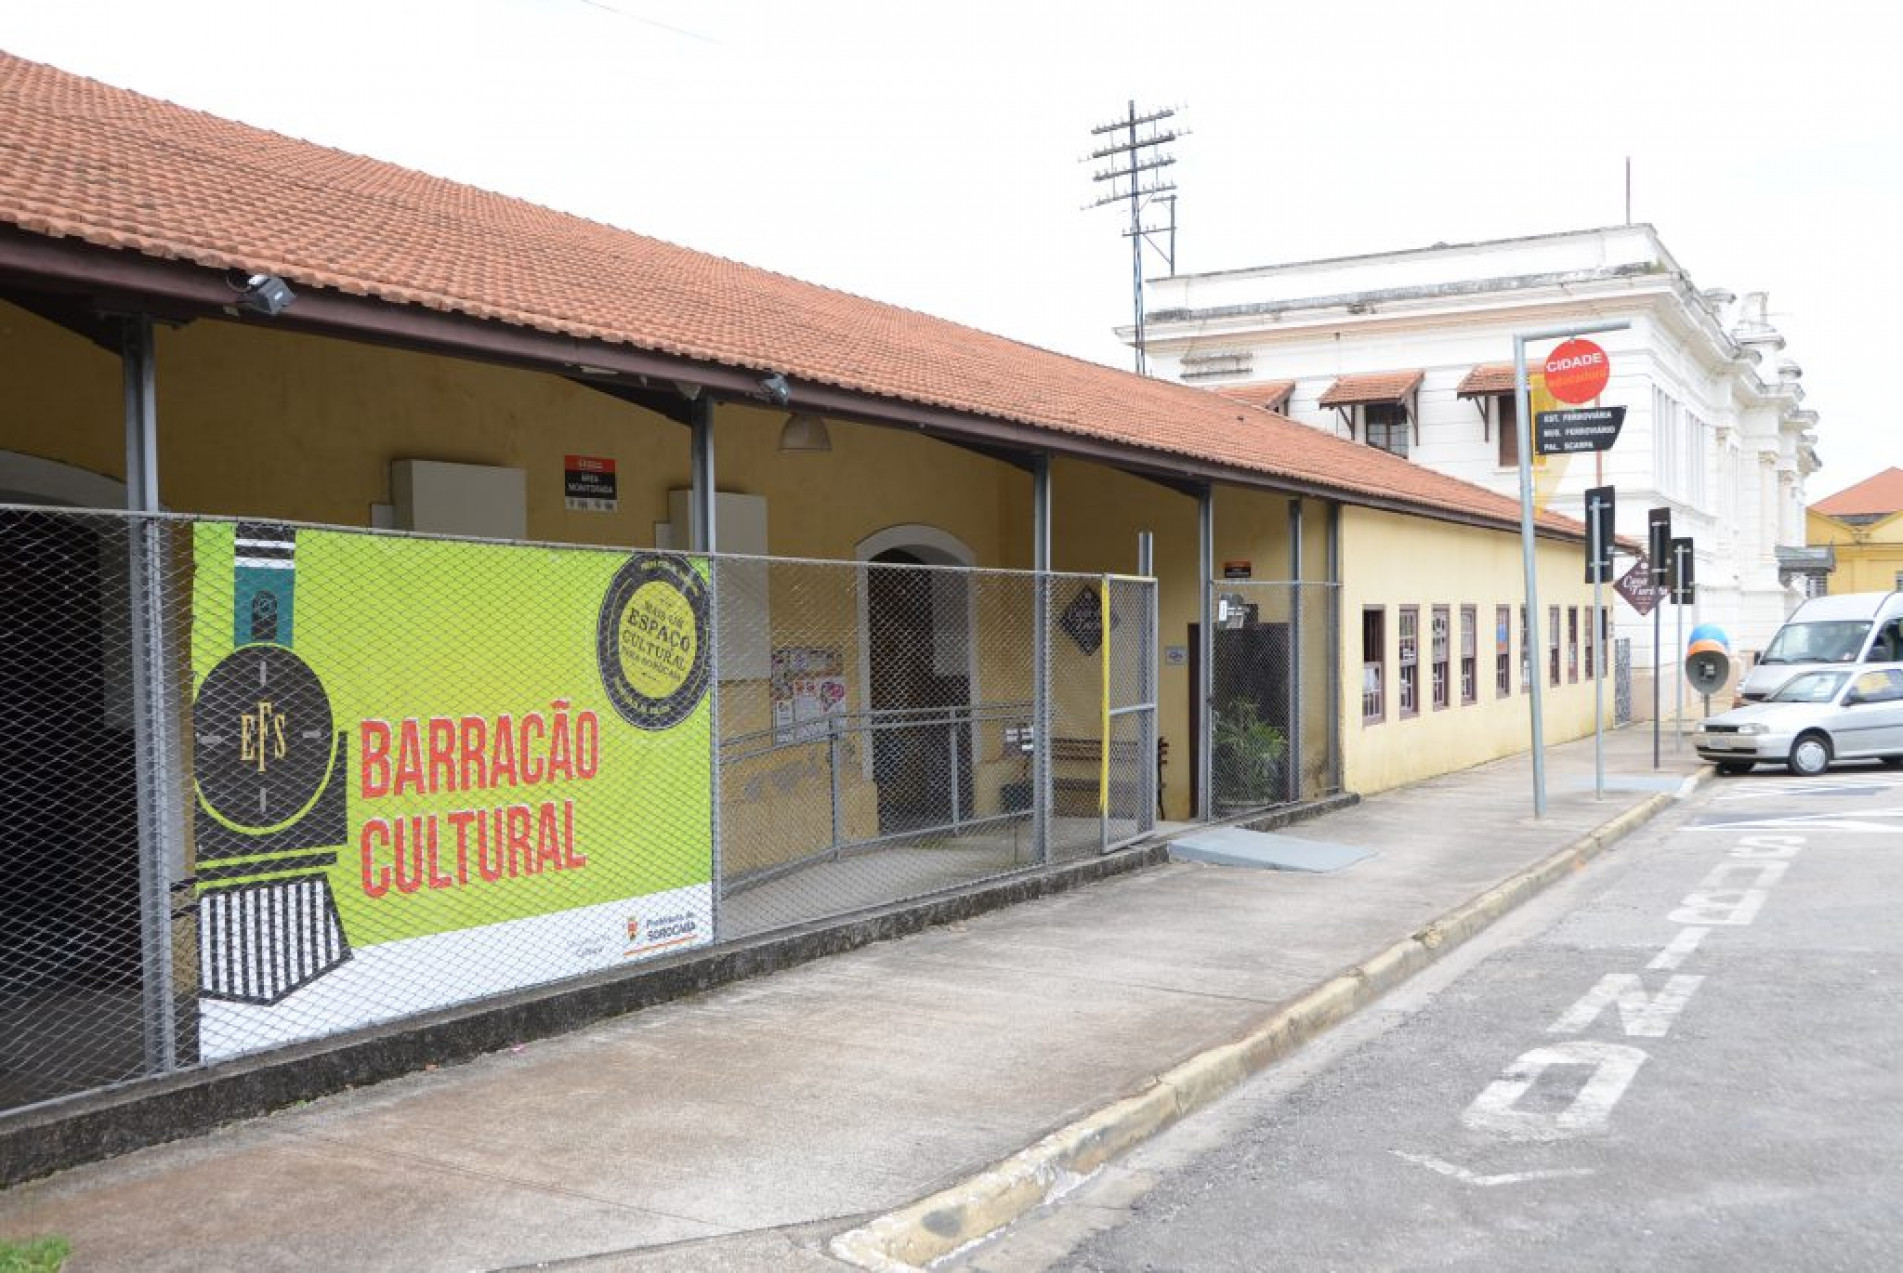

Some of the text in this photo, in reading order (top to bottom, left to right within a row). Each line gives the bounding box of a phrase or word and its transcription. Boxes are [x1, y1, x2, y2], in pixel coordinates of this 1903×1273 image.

[1546, 353, 1602, 372] CIDADE
[622, 629, 686, 673] CULTURAL
[240, 700, 288, 773] EFS
[359, 697, 600, 799] BARRACÃO
[359, 798, 588, 899] CULTURAL
